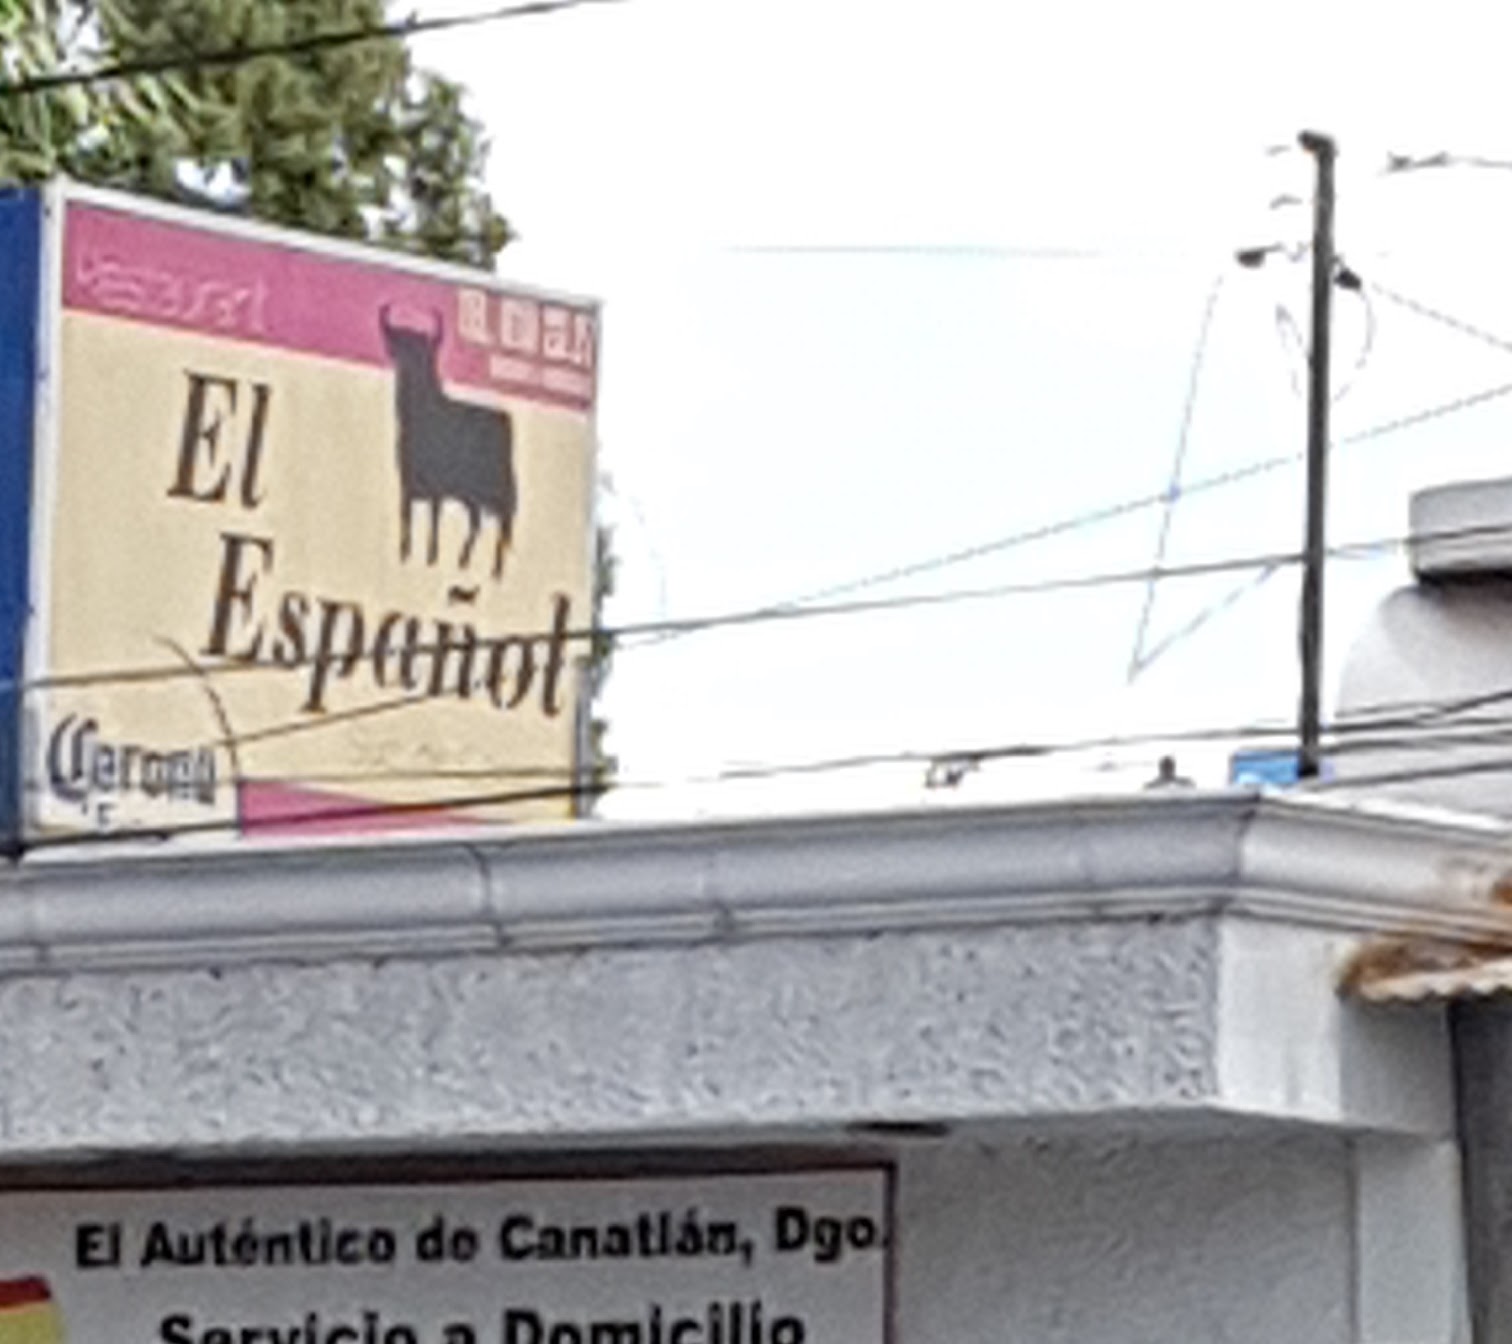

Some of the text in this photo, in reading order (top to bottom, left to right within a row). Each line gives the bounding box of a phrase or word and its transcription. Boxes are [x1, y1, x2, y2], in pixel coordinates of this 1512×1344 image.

[167, 367, 272, 512] El
[199, 530, 573, 719] Español
[74, 1221, 121, 1268] El
[140, 1215, 397, 1267] Auténtico
[415, 1213, 479, 1265] de
[498, 1207, 755, 1267] Canatlán,
